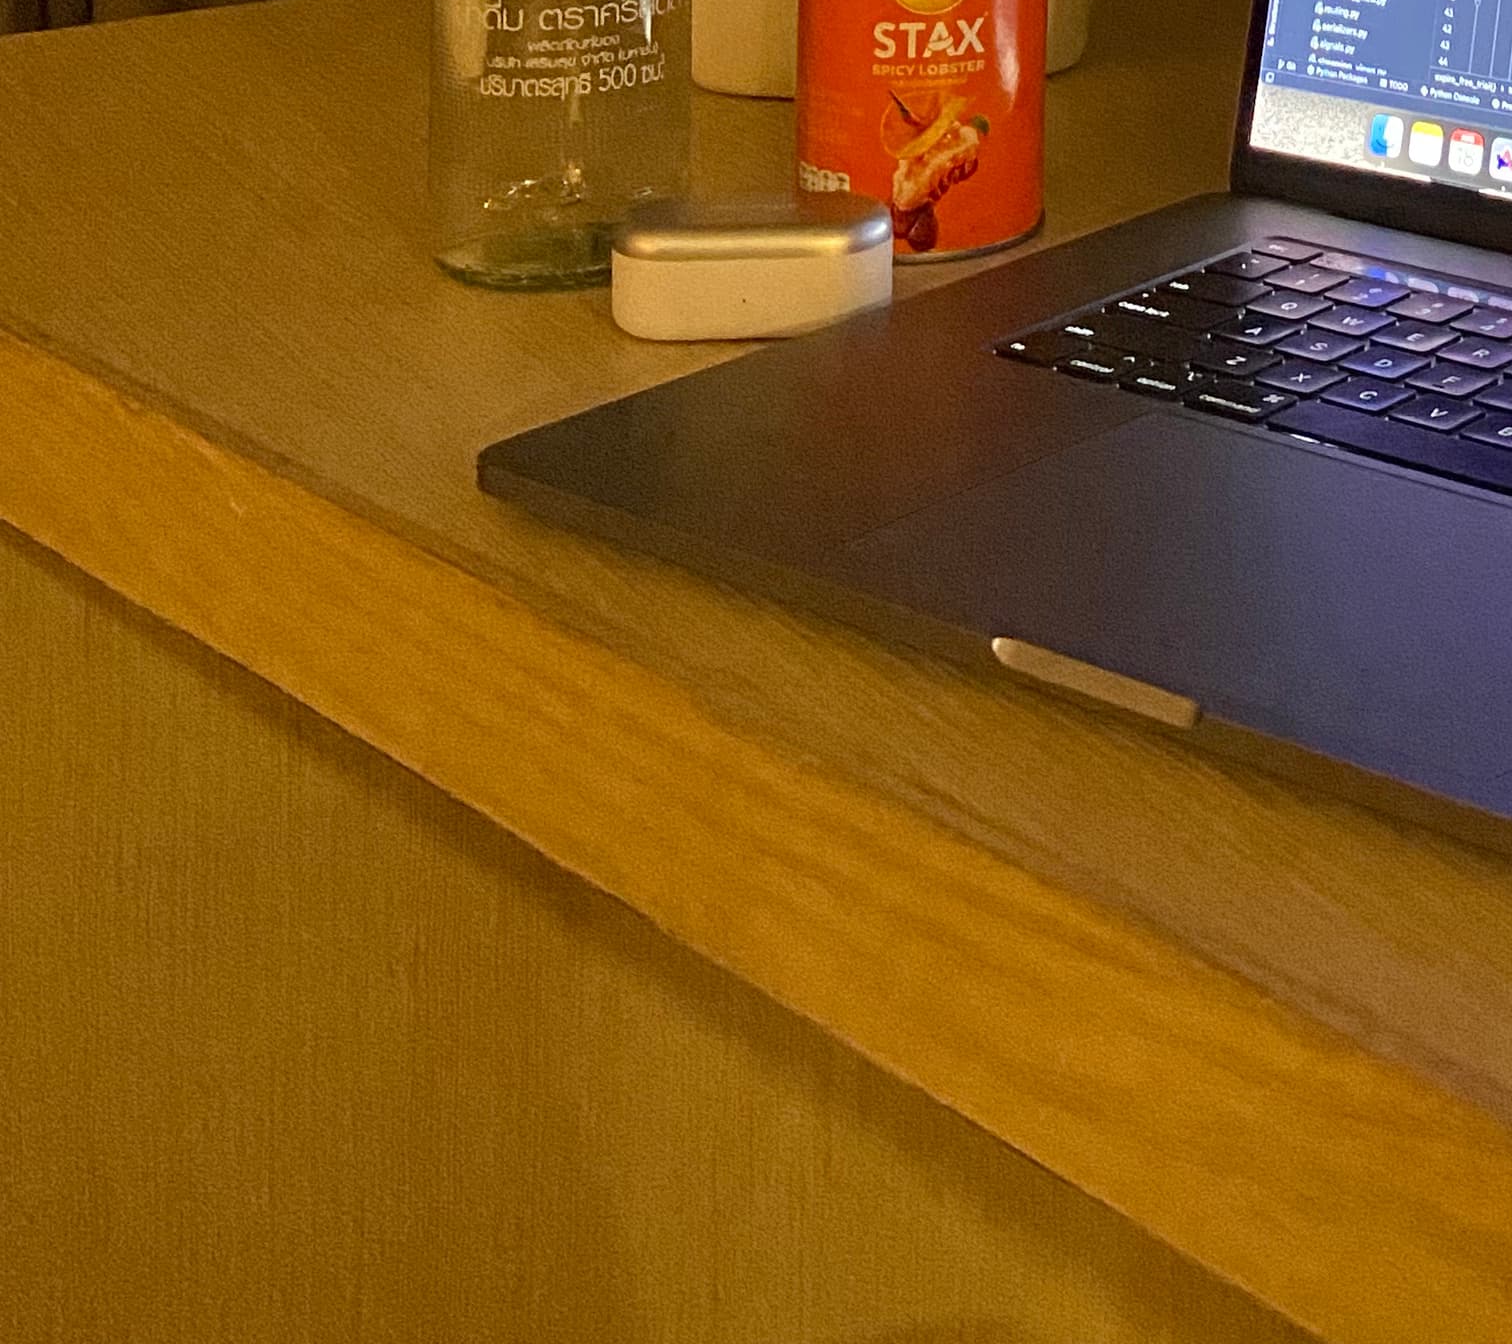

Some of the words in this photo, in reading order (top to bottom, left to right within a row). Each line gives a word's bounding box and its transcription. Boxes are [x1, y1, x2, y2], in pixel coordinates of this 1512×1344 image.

[873, 16, 985, 59] STAX
[598, 62, 638, 93] 500
[872, 63, 915, 76] SPICY
[919, 59, 985, 76] LOBSTER
